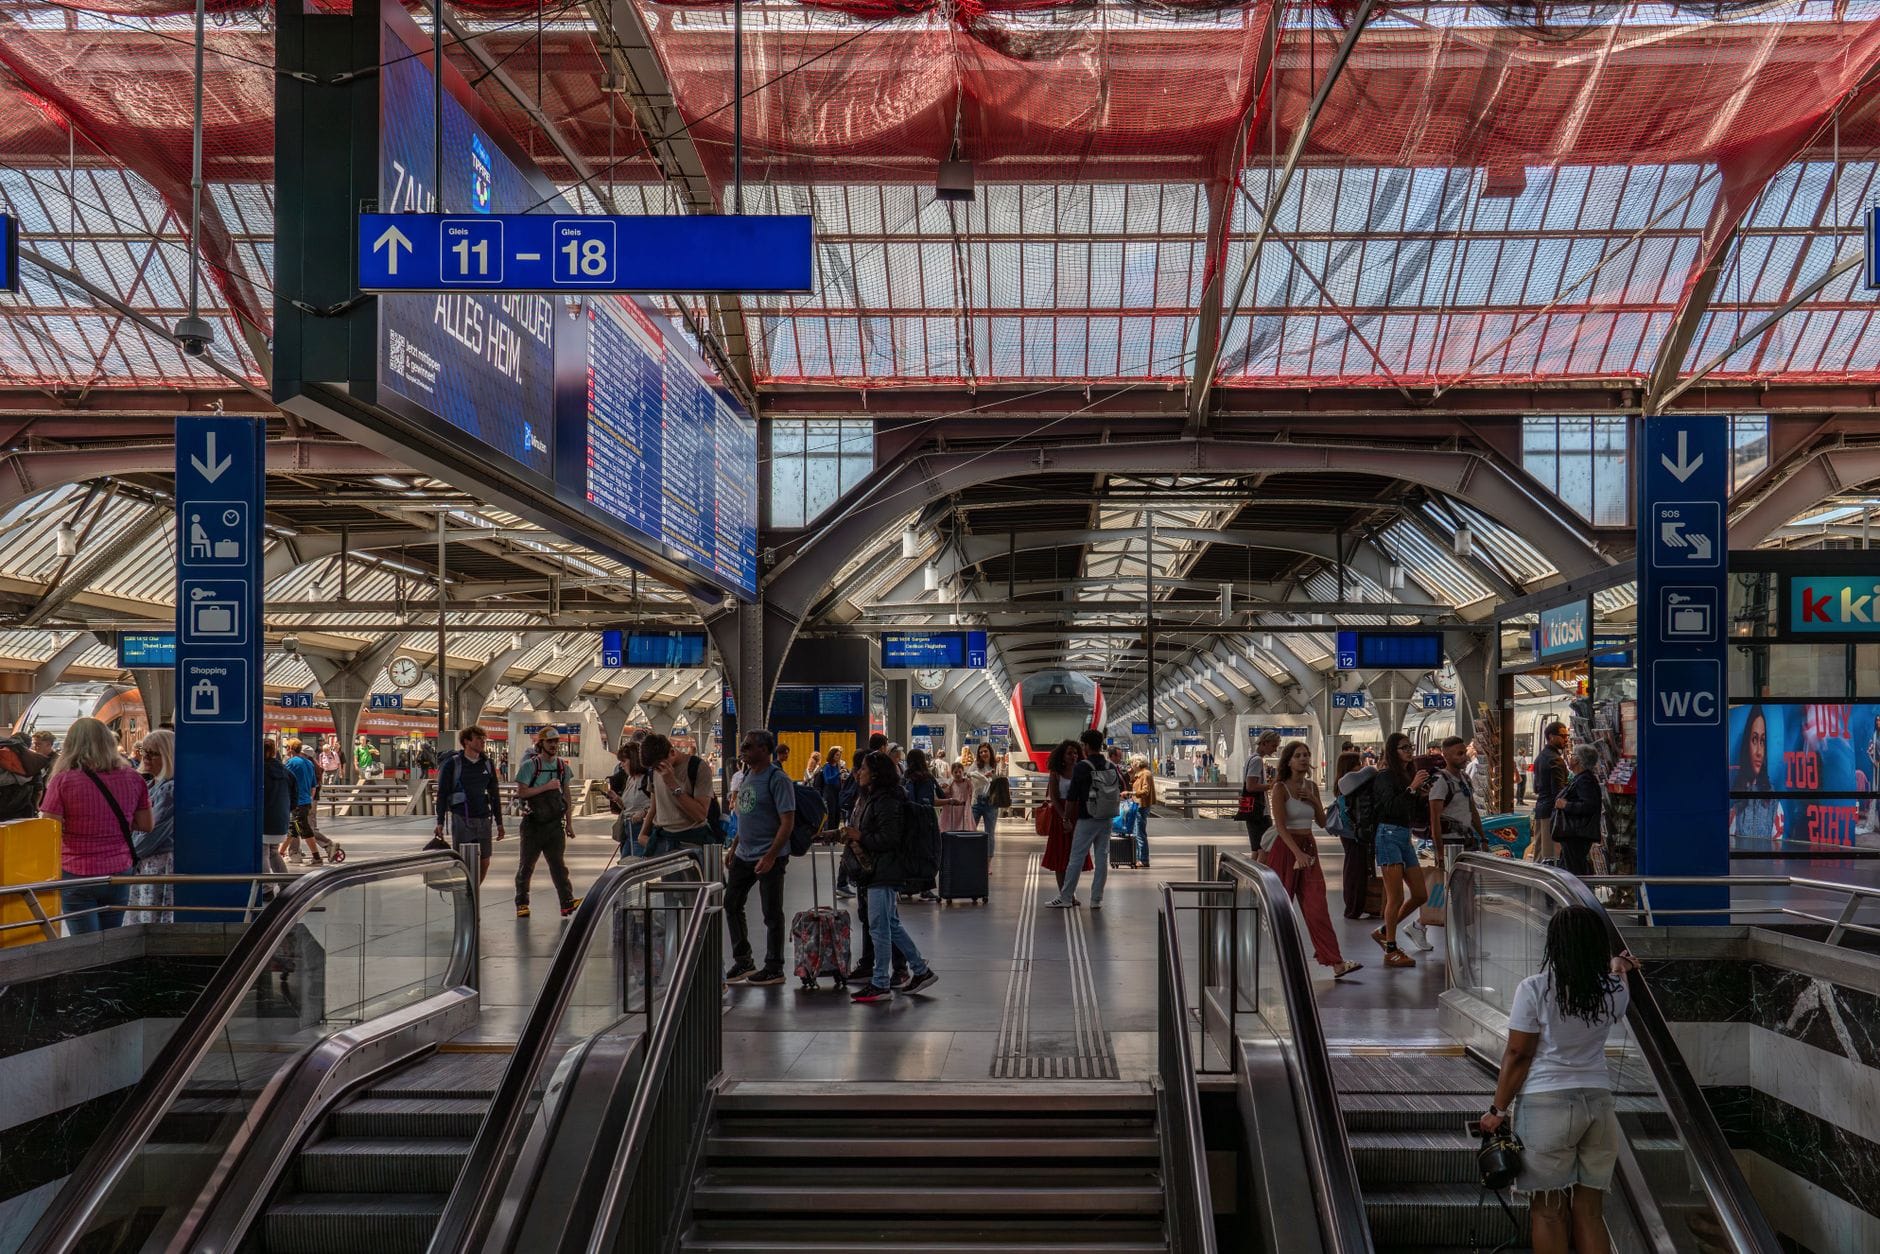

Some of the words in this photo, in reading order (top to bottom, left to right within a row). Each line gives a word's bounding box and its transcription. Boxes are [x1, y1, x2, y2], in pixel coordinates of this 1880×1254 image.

[448, 228, 469, 236] Gleis
[561, 228, 582, 237] Gleis
[452, 239, 488, 275] 11
[561, 238, 607, 276] 18
[1660, 509, 1680, 519] SOS
[1550, 612, 1584, 648] kiosk
[606, 656, 618, 666] 10
[972, 656, 982, 666] 11
[1341, 657, 1353, 667] 12
[190, 666, 227, 676] Shopping
[301, 697, 309, 706] A
[374, 698, 382, 706] A
[390, 698, 398, 706] 9
[920, 698, 929, 706] 11
[1335, 697, 1346, 706] 12
[1353, 697, 1361, 706] A
[1427, 698, 1435, 706] A
[1442, 698, 1453, 706] 13
[1660, 691, 1715, 717] WC
